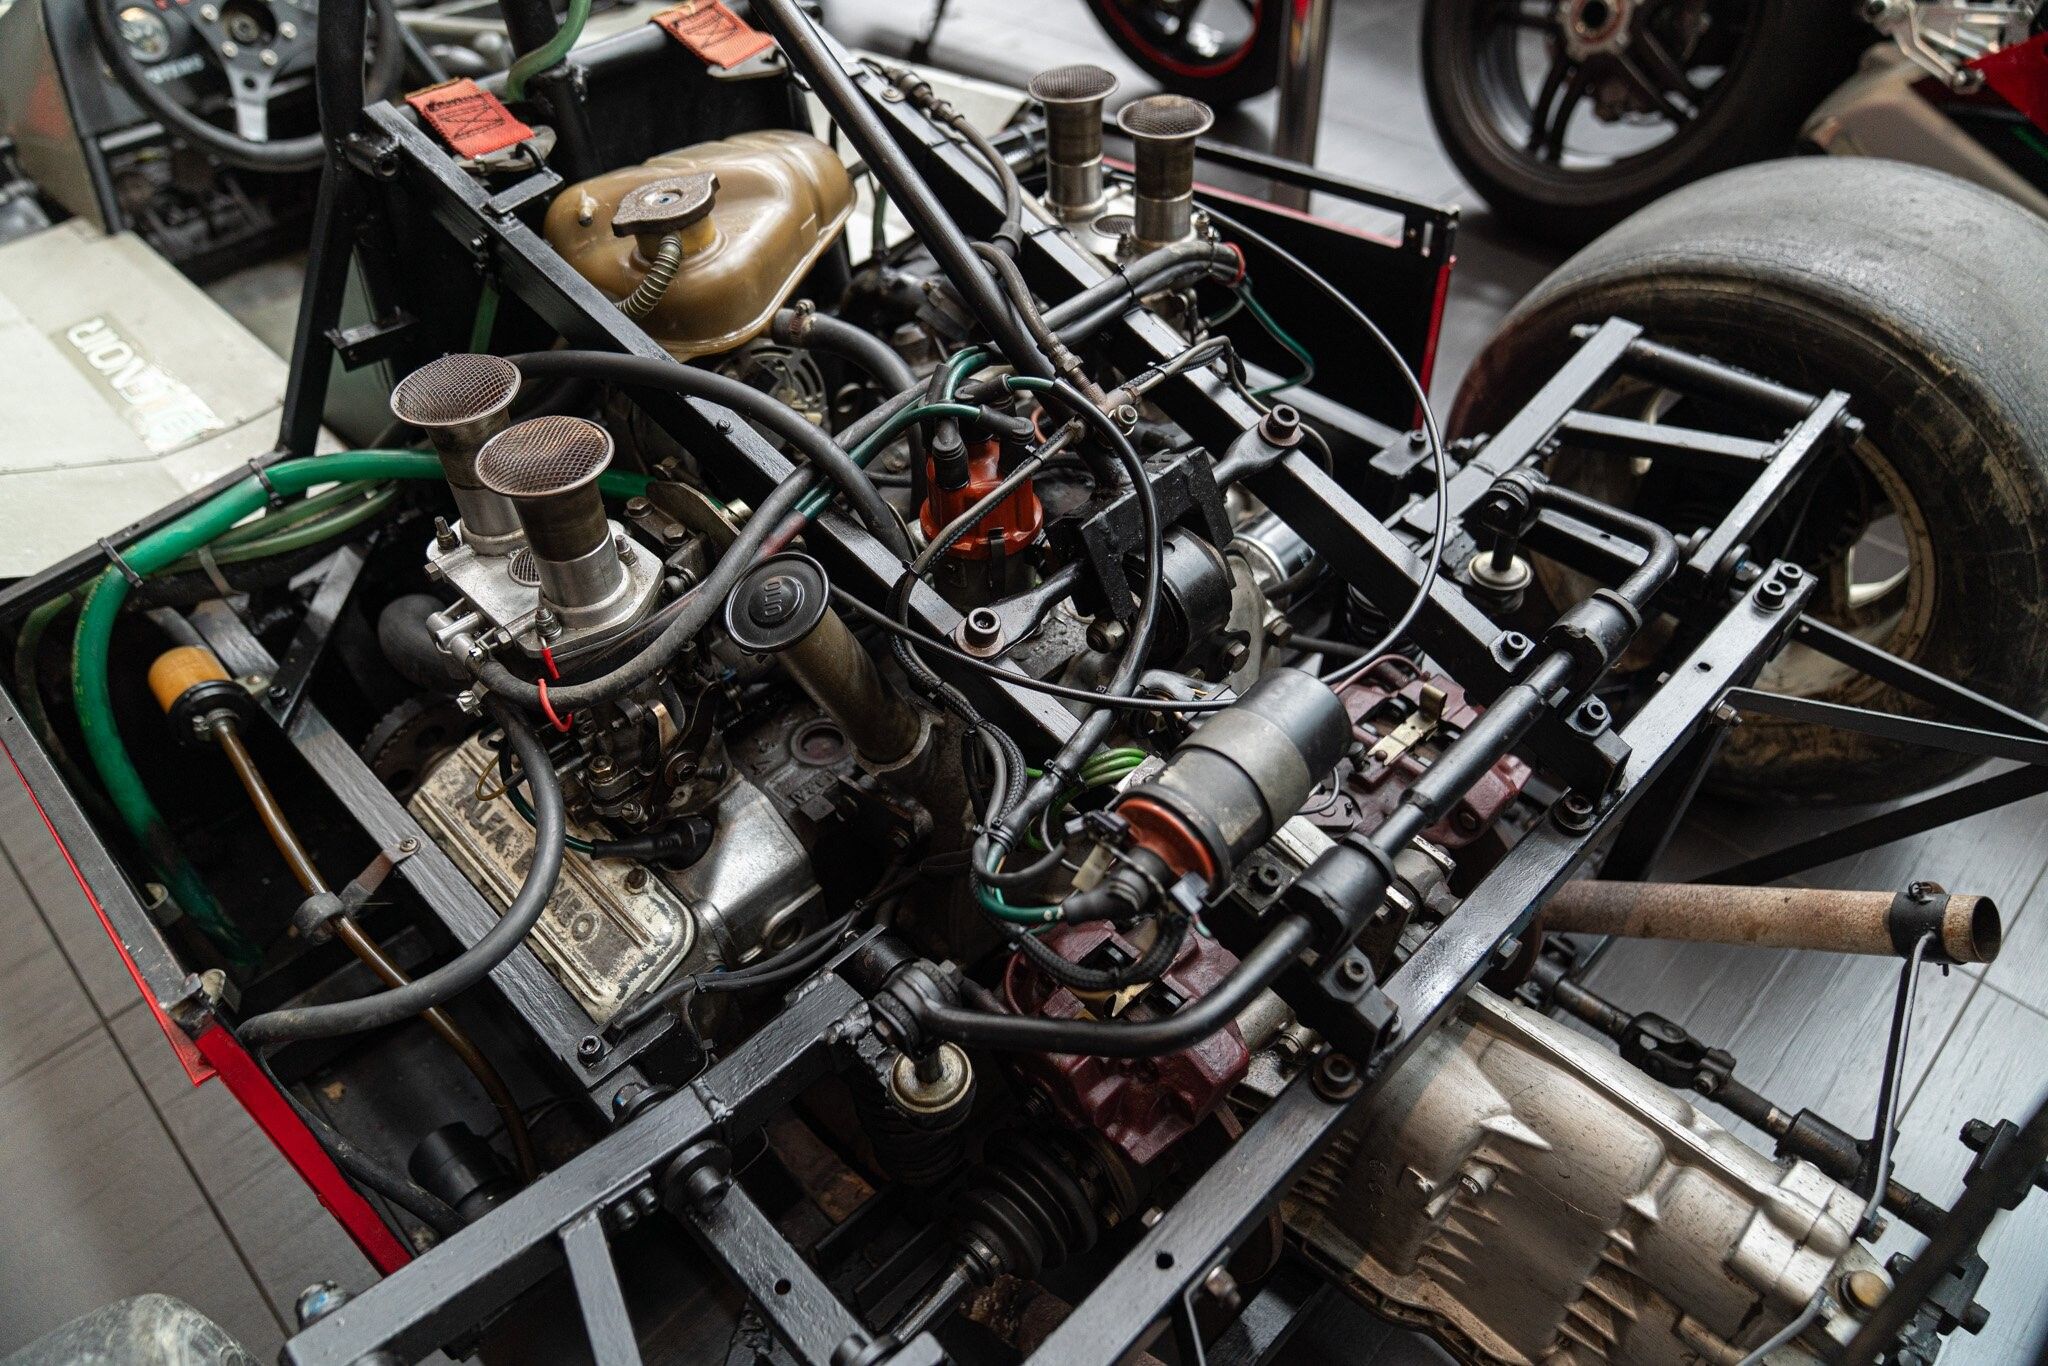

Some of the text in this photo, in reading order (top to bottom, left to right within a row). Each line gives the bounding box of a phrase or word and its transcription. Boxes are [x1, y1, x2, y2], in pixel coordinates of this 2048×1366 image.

[764, 581, 782, 617] OLIO
[455, 793, 597, 943] ALFA RMEO
